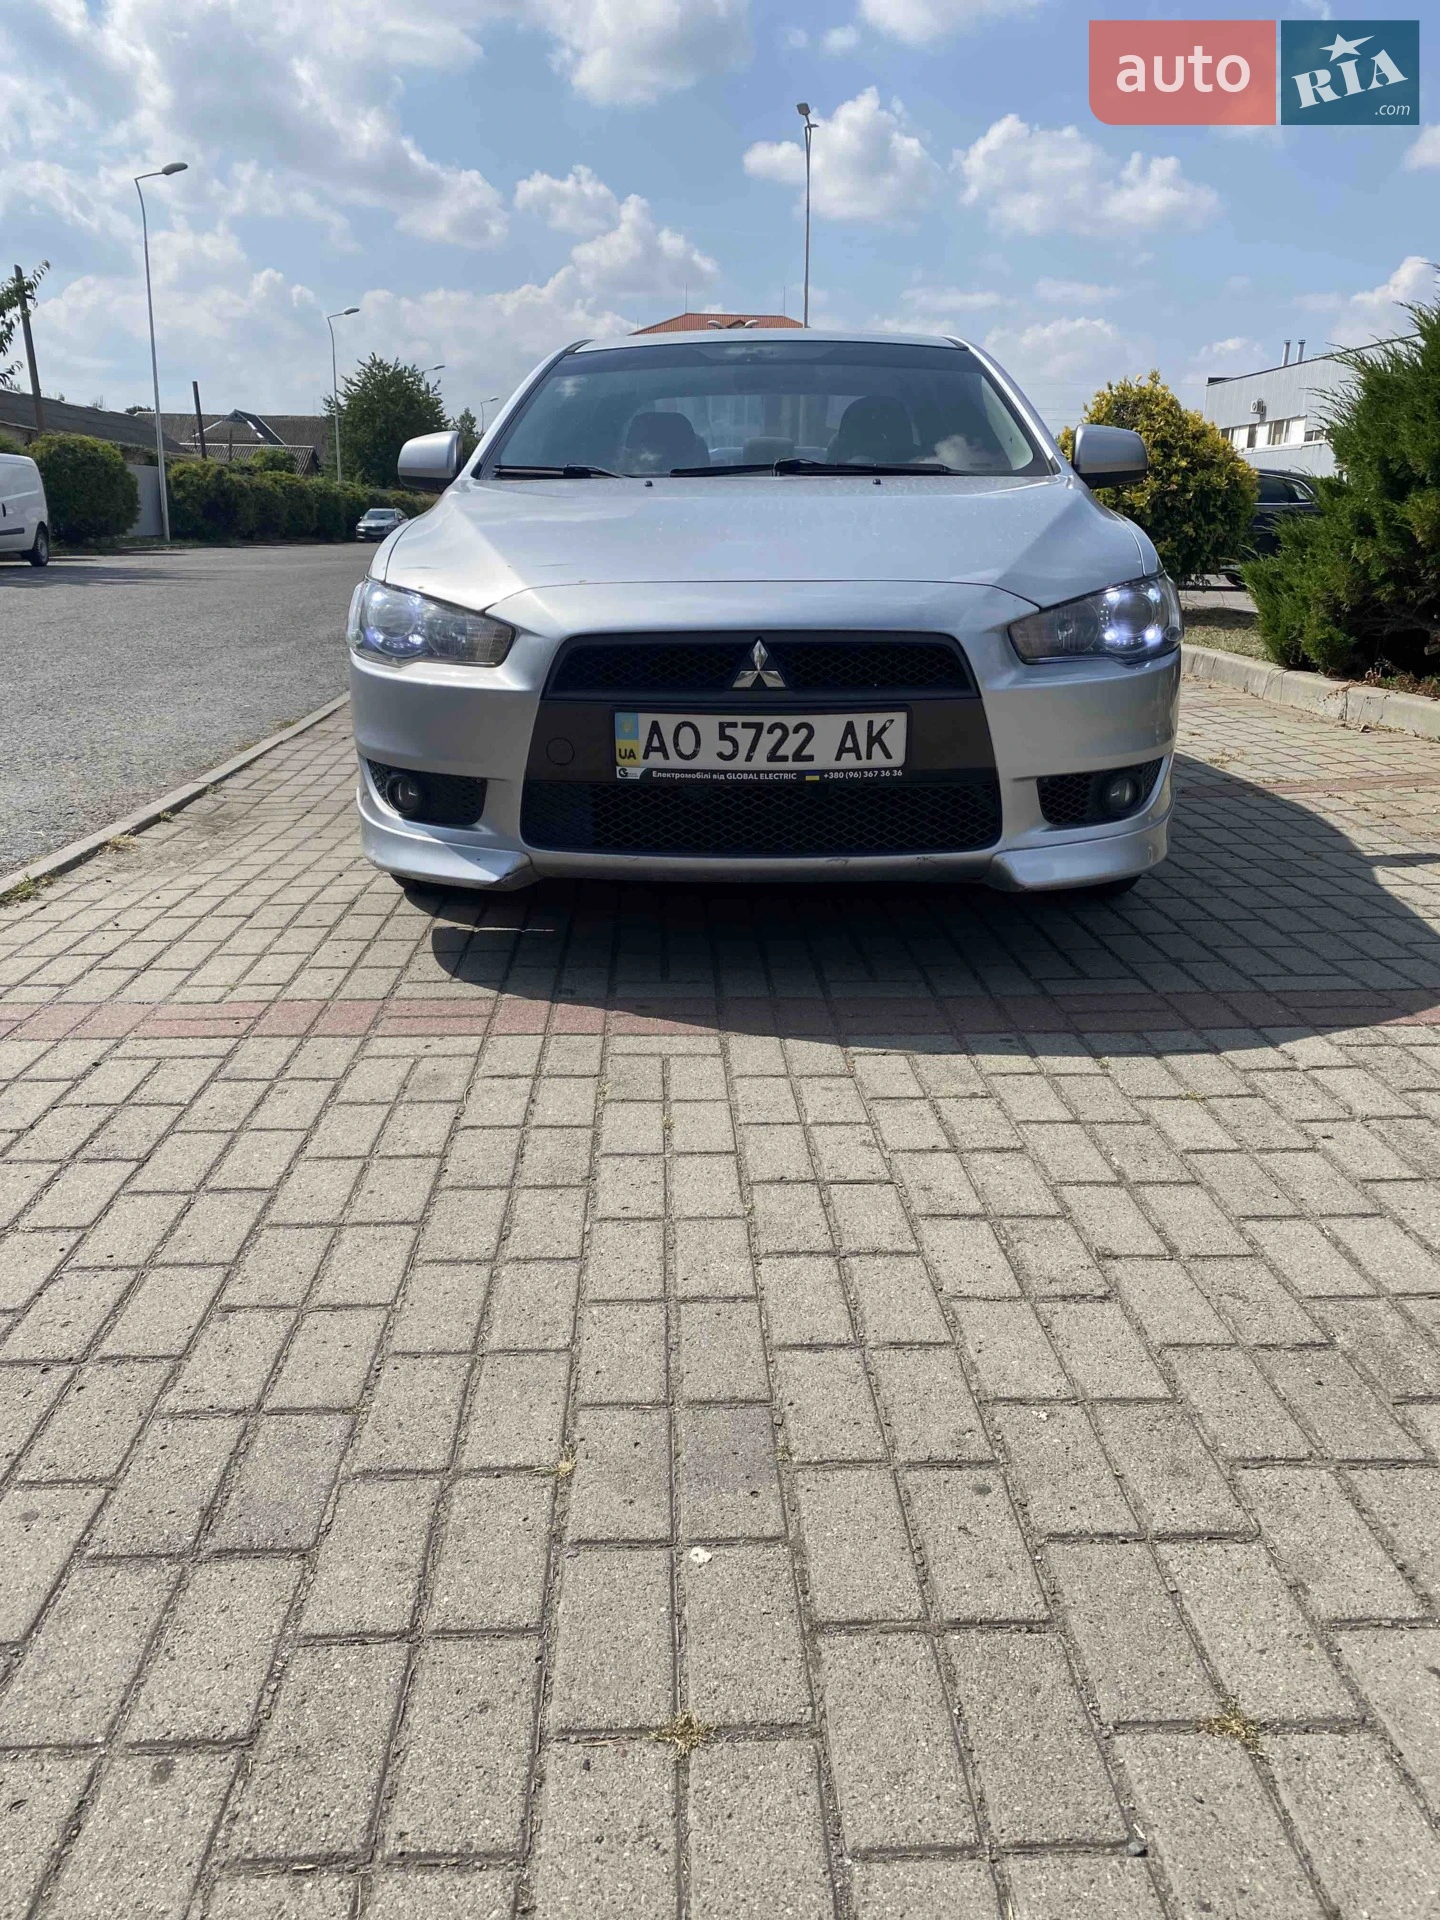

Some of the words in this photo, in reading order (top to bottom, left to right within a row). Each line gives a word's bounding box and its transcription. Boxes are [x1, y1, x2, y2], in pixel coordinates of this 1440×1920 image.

[642, 720, 702, 761] AO
[716, 721, 815, 763] 5722
[834, 719, 895, 762] AK
[618, 748, 637, 760] UA
[652, 770, 711, 780] Електромобілі
[712, 772, 726, 781] від
[726, 772, 759, 780] GLOBAL
[759, 772, 797, 780] ELECTRIC
[823, 771, 844, 779] +380
[845, 771, 862, 779] (96)
[863, 770, 878, 778] 367
[880, 769, 891, 777] 36
